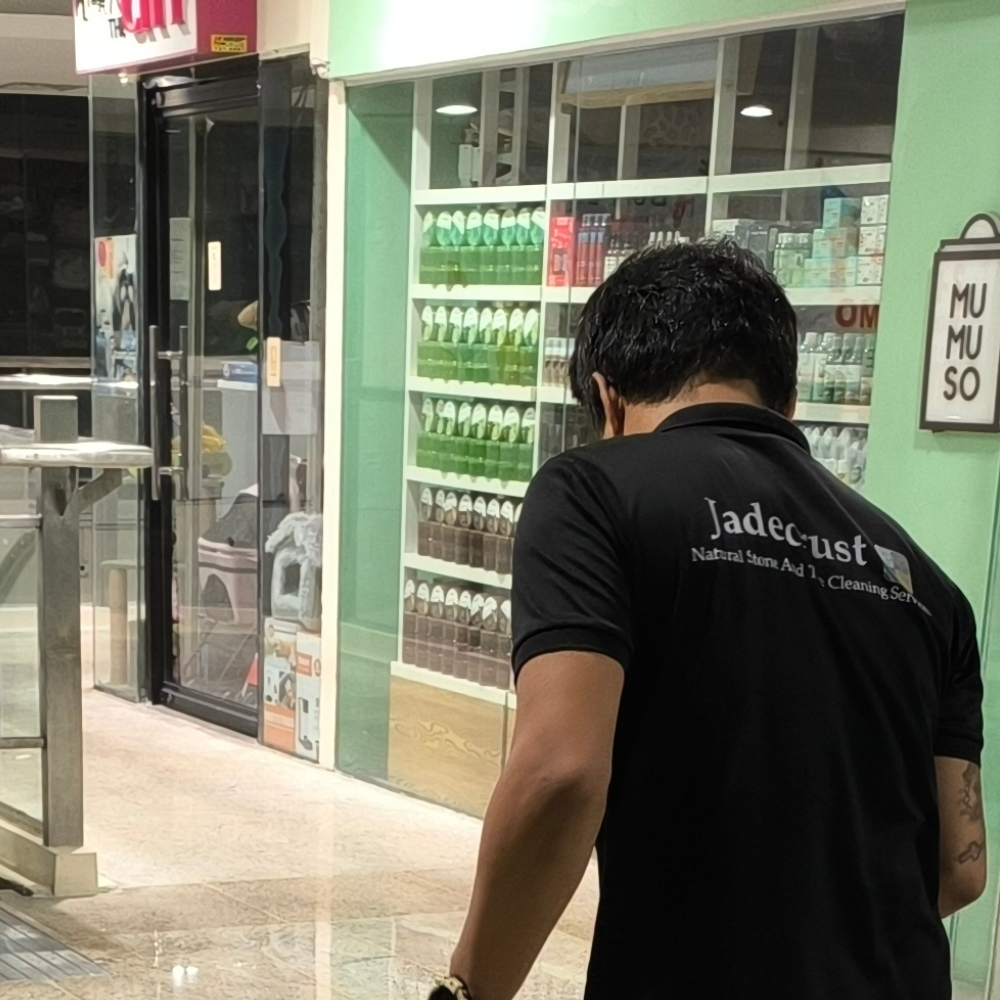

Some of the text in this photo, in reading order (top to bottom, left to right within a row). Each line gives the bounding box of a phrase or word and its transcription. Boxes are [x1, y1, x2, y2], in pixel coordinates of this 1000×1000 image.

[949, 283, 987, 319] MU
[946, 325, 983, 360] MU
[943, 366, 981, 402] SO
[827, 575, 889, 600] Cleaning
